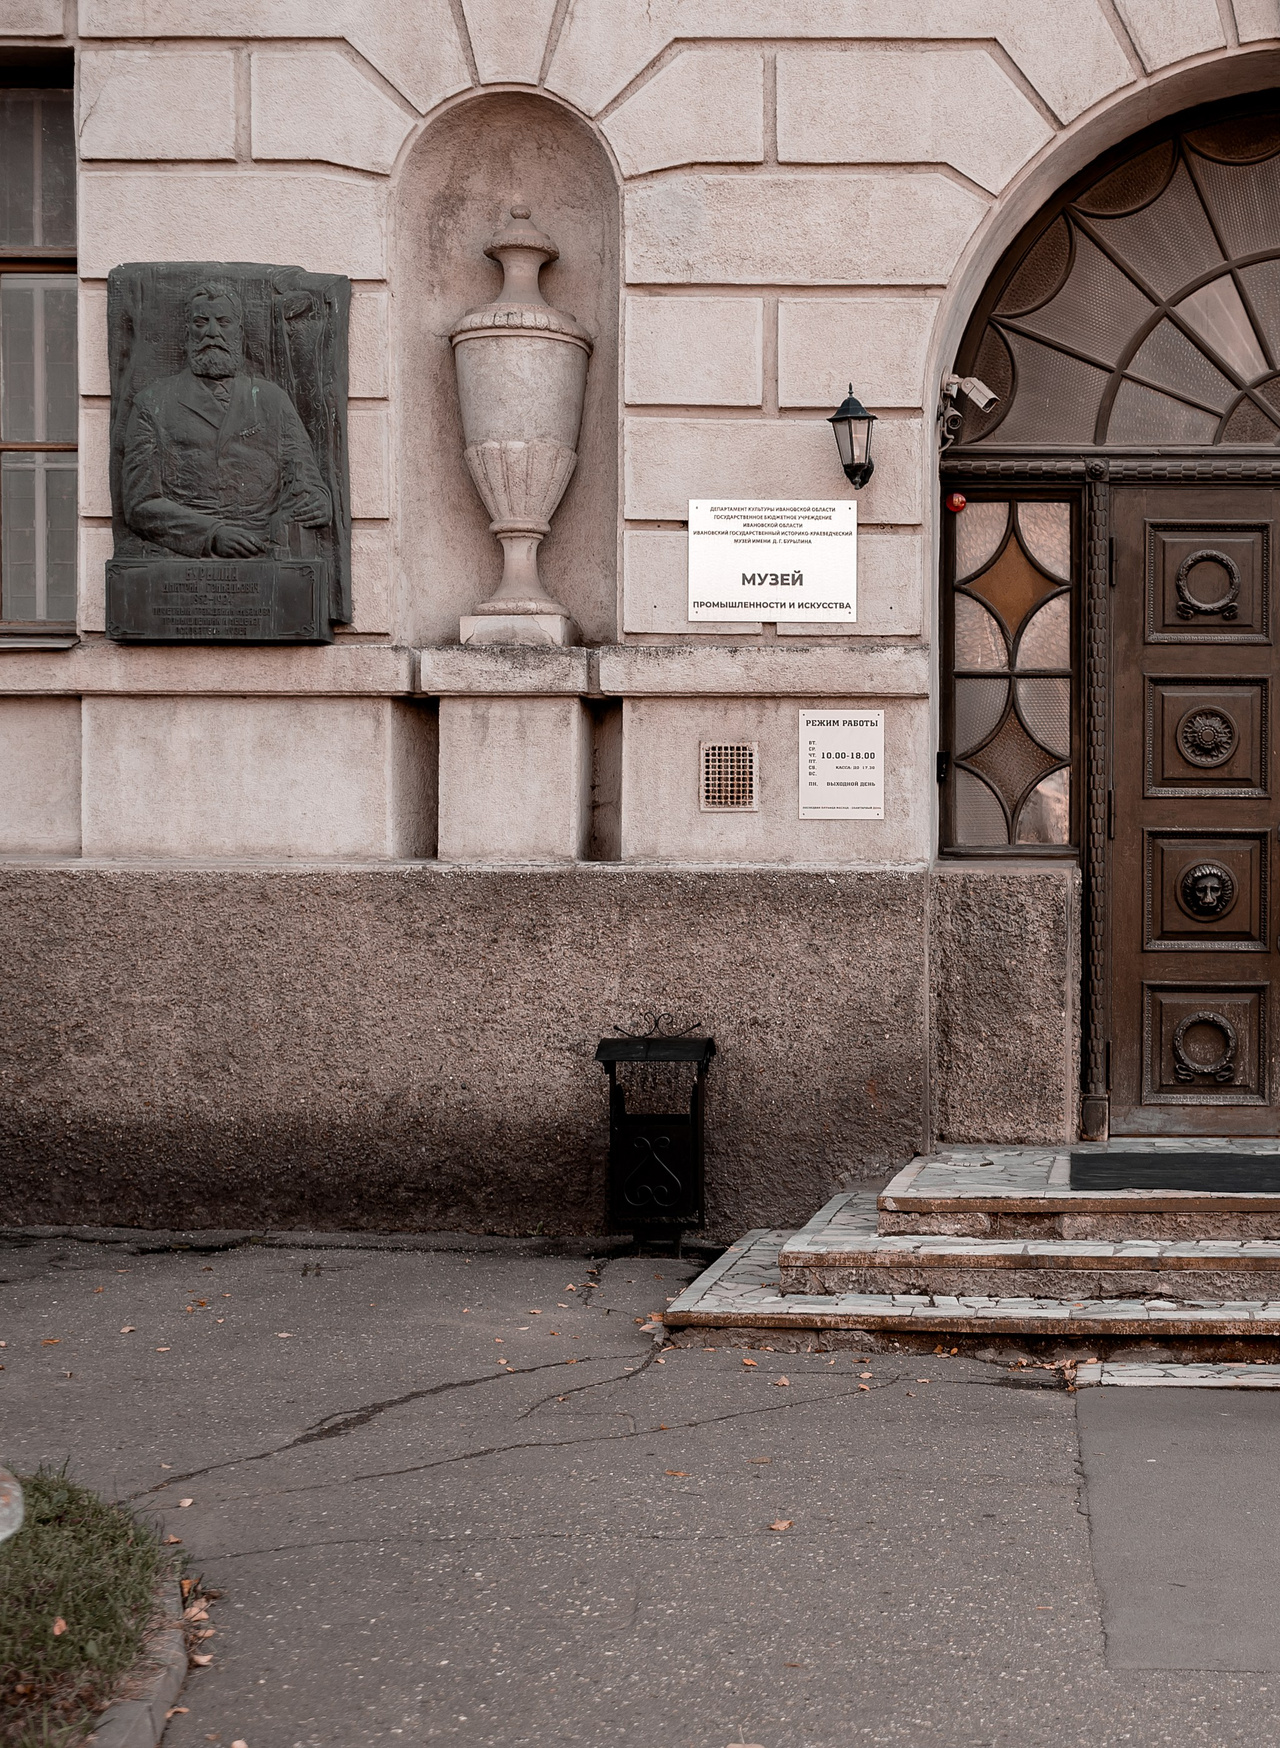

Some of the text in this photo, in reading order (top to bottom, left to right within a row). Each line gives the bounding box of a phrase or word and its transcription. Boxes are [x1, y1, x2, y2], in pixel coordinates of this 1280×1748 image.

[741, 570, 804, 587] МУЗЕЙ
[692, 601, 786, 610] ПРОМЫШЛЕННОСТИ
[798, 601, 852, 610] ИСКУССТВА
[806, 719, 878, 727] РЕЖИМ РАБОТЫ
[821, 752, 876, 760] 10.00-18.00
